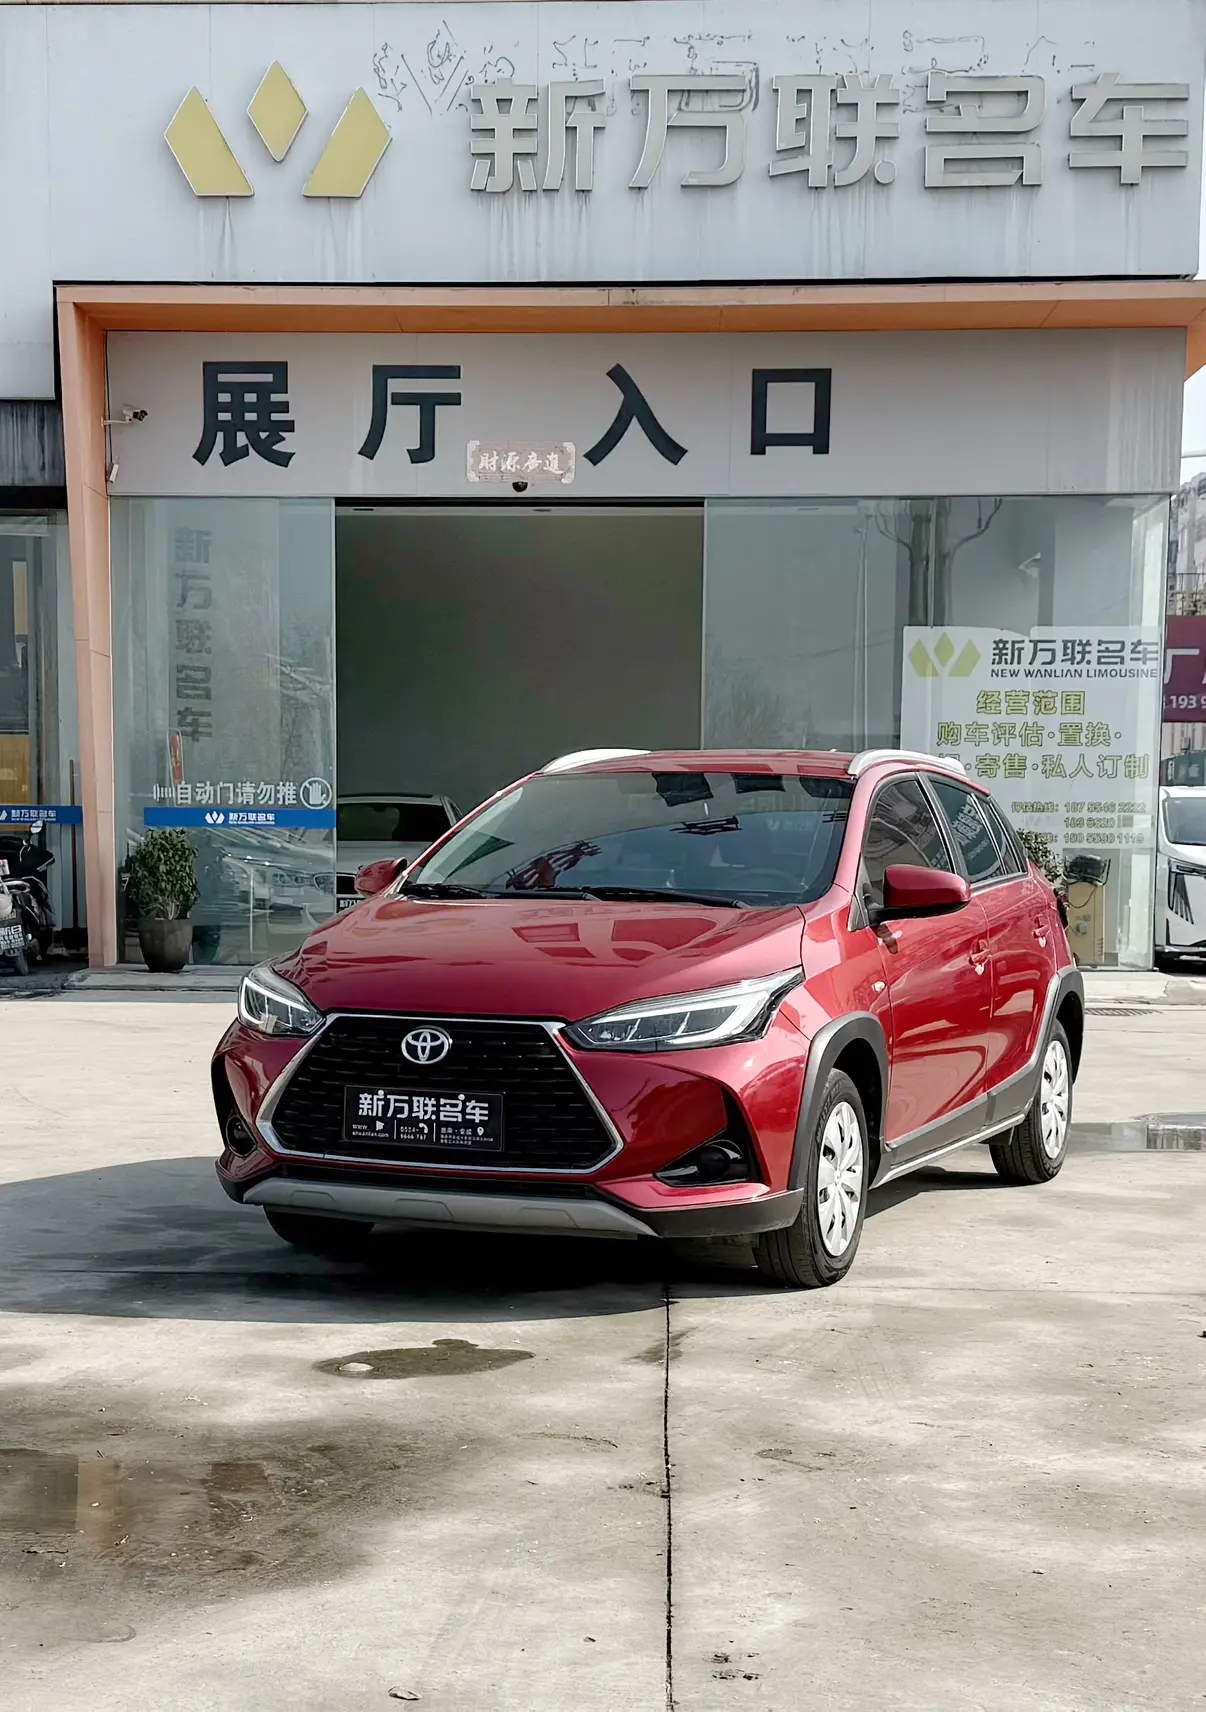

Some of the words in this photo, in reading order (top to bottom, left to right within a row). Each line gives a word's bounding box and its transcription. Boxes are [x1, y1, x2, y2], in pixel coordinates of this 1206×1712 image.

[470, 71, 1190, 193] 新万联名车
[192, 359, 833, 468] 展厅入口
[174, 526, 213, 744] 新万联名车
[991, 638, 1159, 666] 新万联名车
[1164, 648, 1206, 685] 厂
[991, 668, 1019, 679] NEW
[1024, 668, 1082, 679] WANLIAN
[1086, 668, 1158, 679] LIMOUSINE
[976, 690, 1086, 715] 经营范围
[1169, 695, 1198, 709] 193
[177, 780, 298, 805] 自动门请勿推
[358, 1093, 489, 1123] 新万联名车
